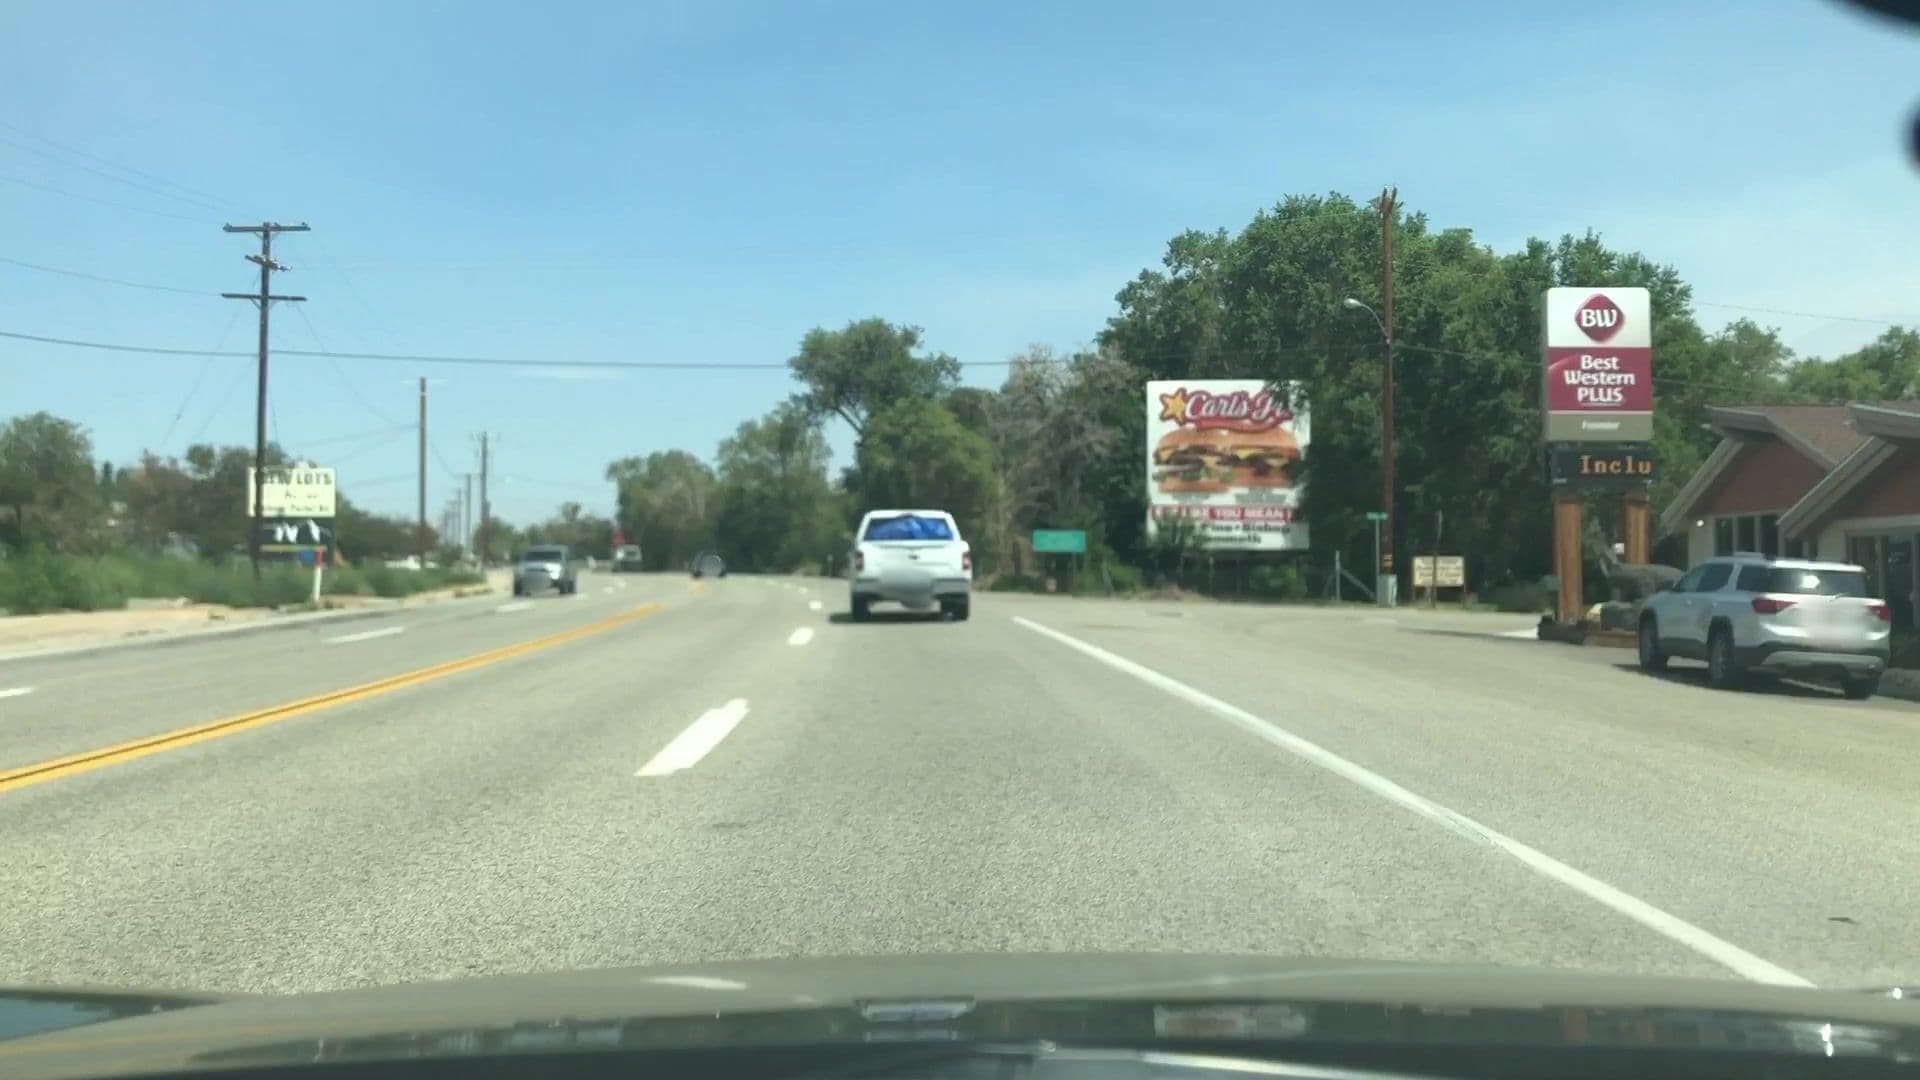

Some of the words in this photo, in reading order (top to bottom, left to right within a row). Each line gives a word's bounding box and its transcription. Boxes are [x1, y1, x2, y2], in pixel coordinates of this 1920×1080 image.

[1581, 309, 1618, 327] BW
[1581, 355, 1620, 369] Best
[1564, 371, 1635, 385] Western
[1577, 387, 1623, 402] PLUS
[1581, 455, 1651, 473] Inclu
